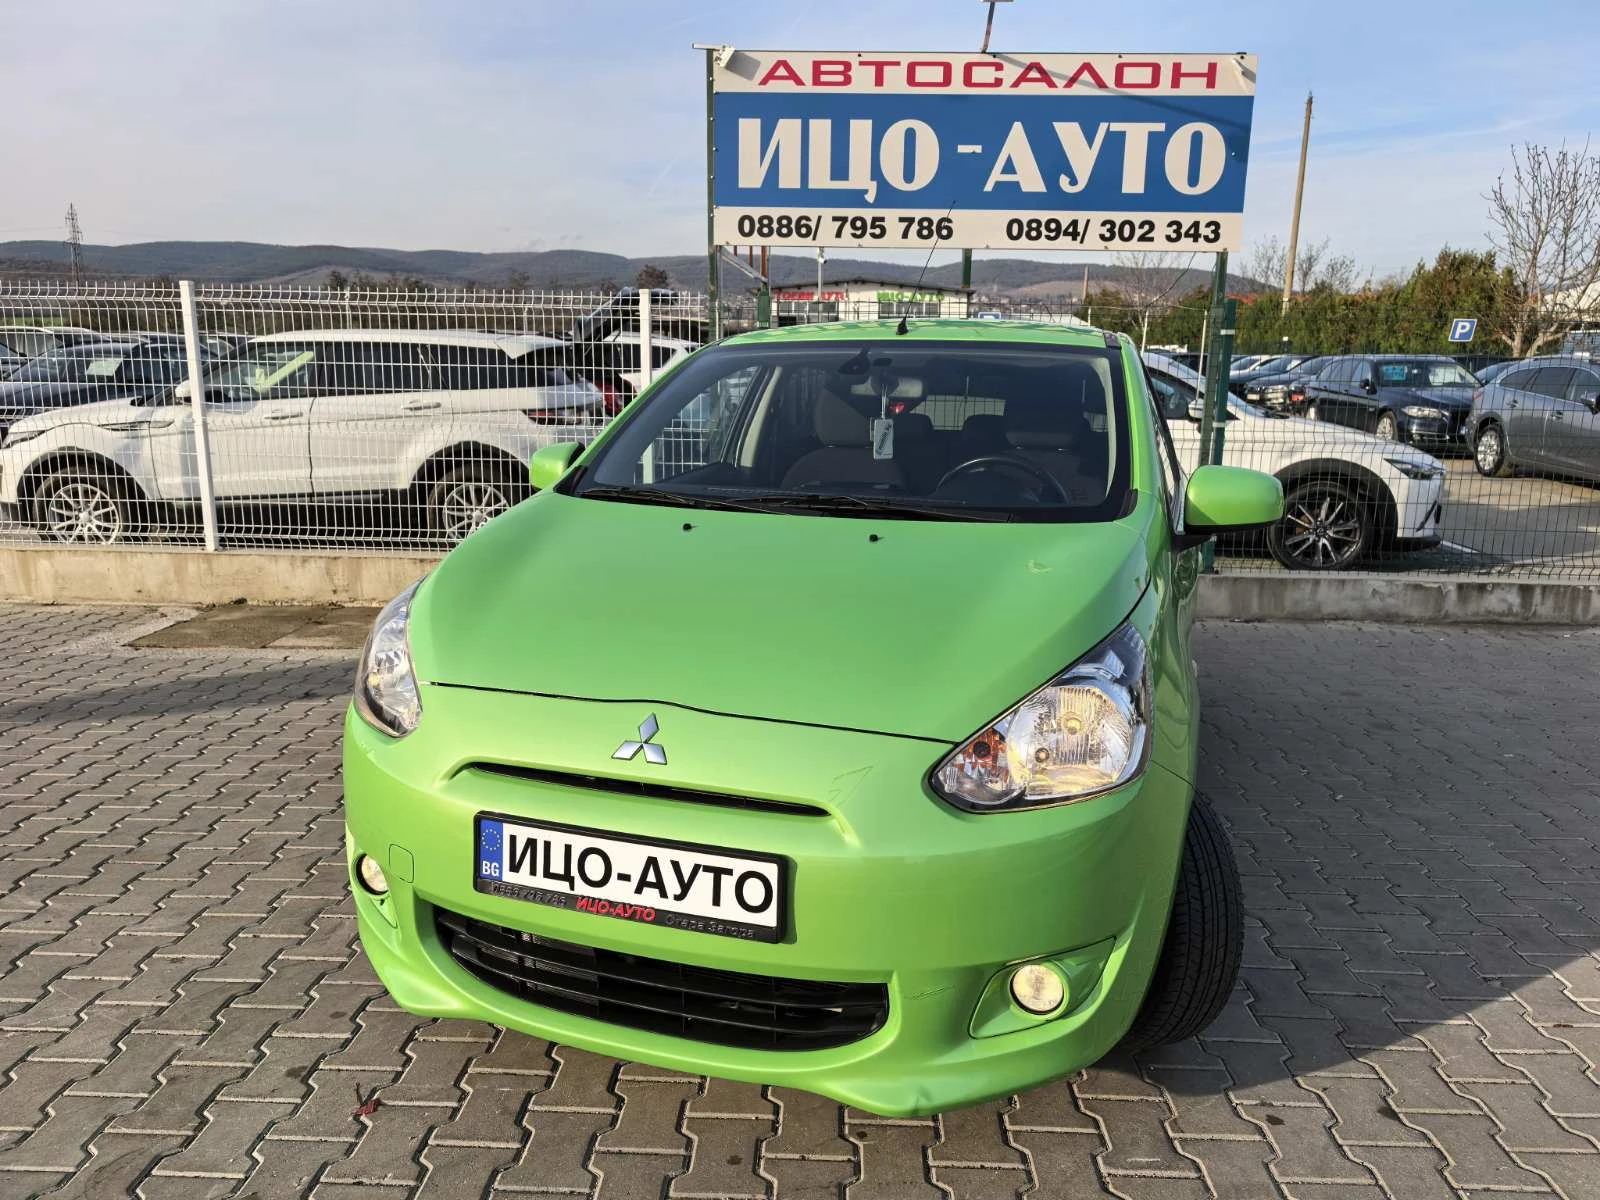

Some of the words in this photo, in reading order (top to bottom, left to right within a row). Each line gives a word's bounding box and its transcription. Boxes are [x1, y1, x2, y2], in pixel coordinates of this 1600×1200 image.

[758, 59, 1218, 89] АВТОСАЛОН
[738, 215, 821, 240] 0886/
[832, 216, 886, 239] 795
[898, 217, 954, 241] 786
[1006, 218, 1090, 244] 0894/
[1099, 220, 1155, 243] 302
[1165, 221, 1221, 244] 343
[1454, 322, 1471, 339] P
[482, 860, 500, 877] BG
[508, 834, 774, 914] ИЦО-АУТО
[576, 897, 656, 921] ИЦО-АУТО
